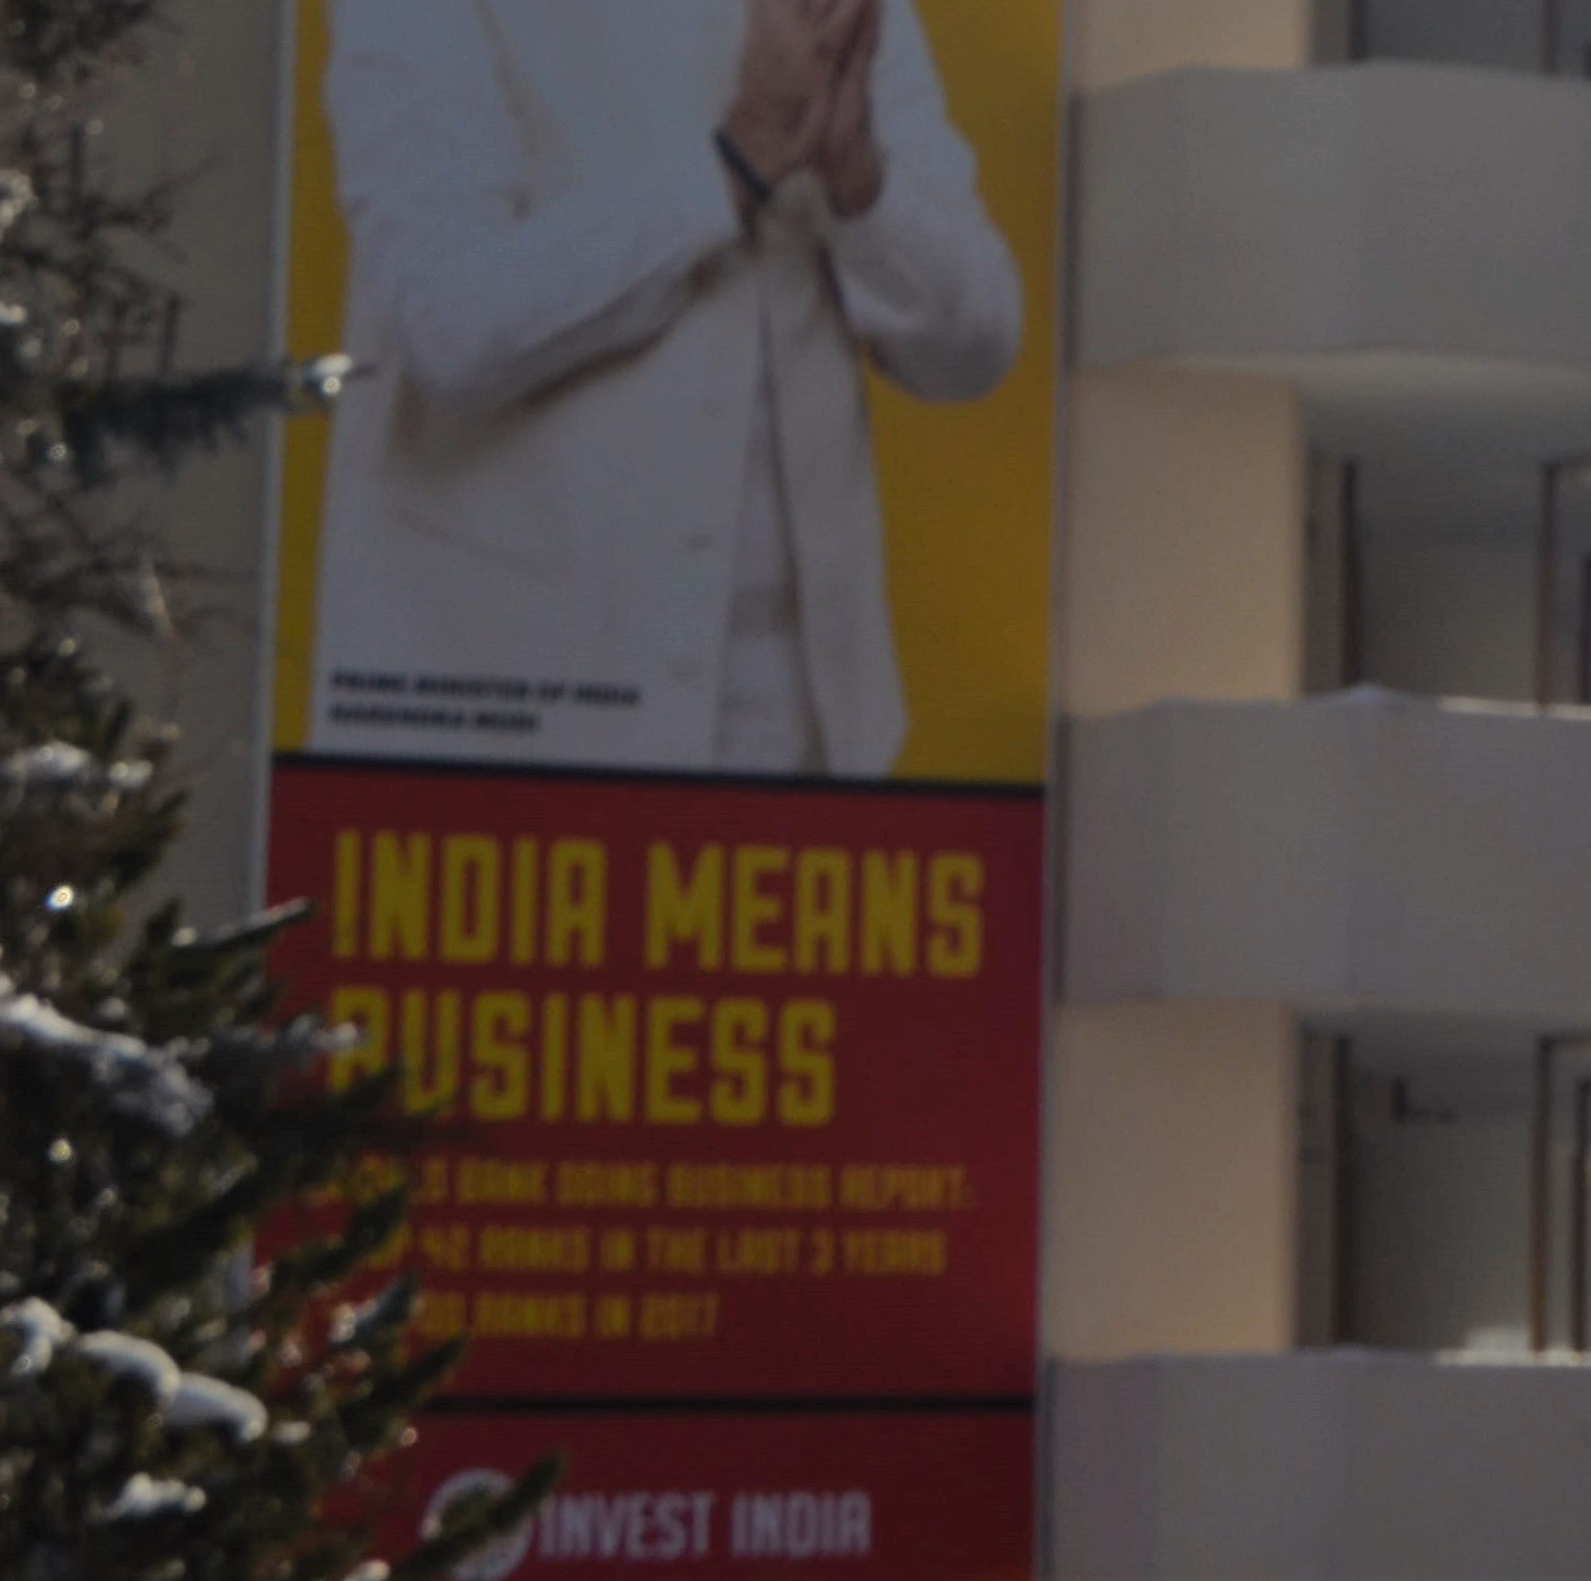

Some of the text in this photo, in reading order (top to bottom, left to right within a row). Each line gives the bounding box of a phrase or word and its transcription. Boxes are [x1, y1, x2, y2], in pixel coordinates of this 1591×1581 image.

[330, 828, 987, 980] INDIA MEANS
[325, 984, 838, 1128] BUSINESS
[667, 1160, 831, 1212] BUSINESS
[480, 1223, 589, 1273] RANKS
[599, 1227, 634, 1274] IN
[646, 1227, 708, 1276] THE
[717, 1228, 800, 1277] LAST
[844, 1228, 946, 1278] YEARS
[474, 1290, 586, 1340] RANKS
[597, 1292, 631, 1341] IN
[538, 1487, 874, 1564] INVEST INDIA
